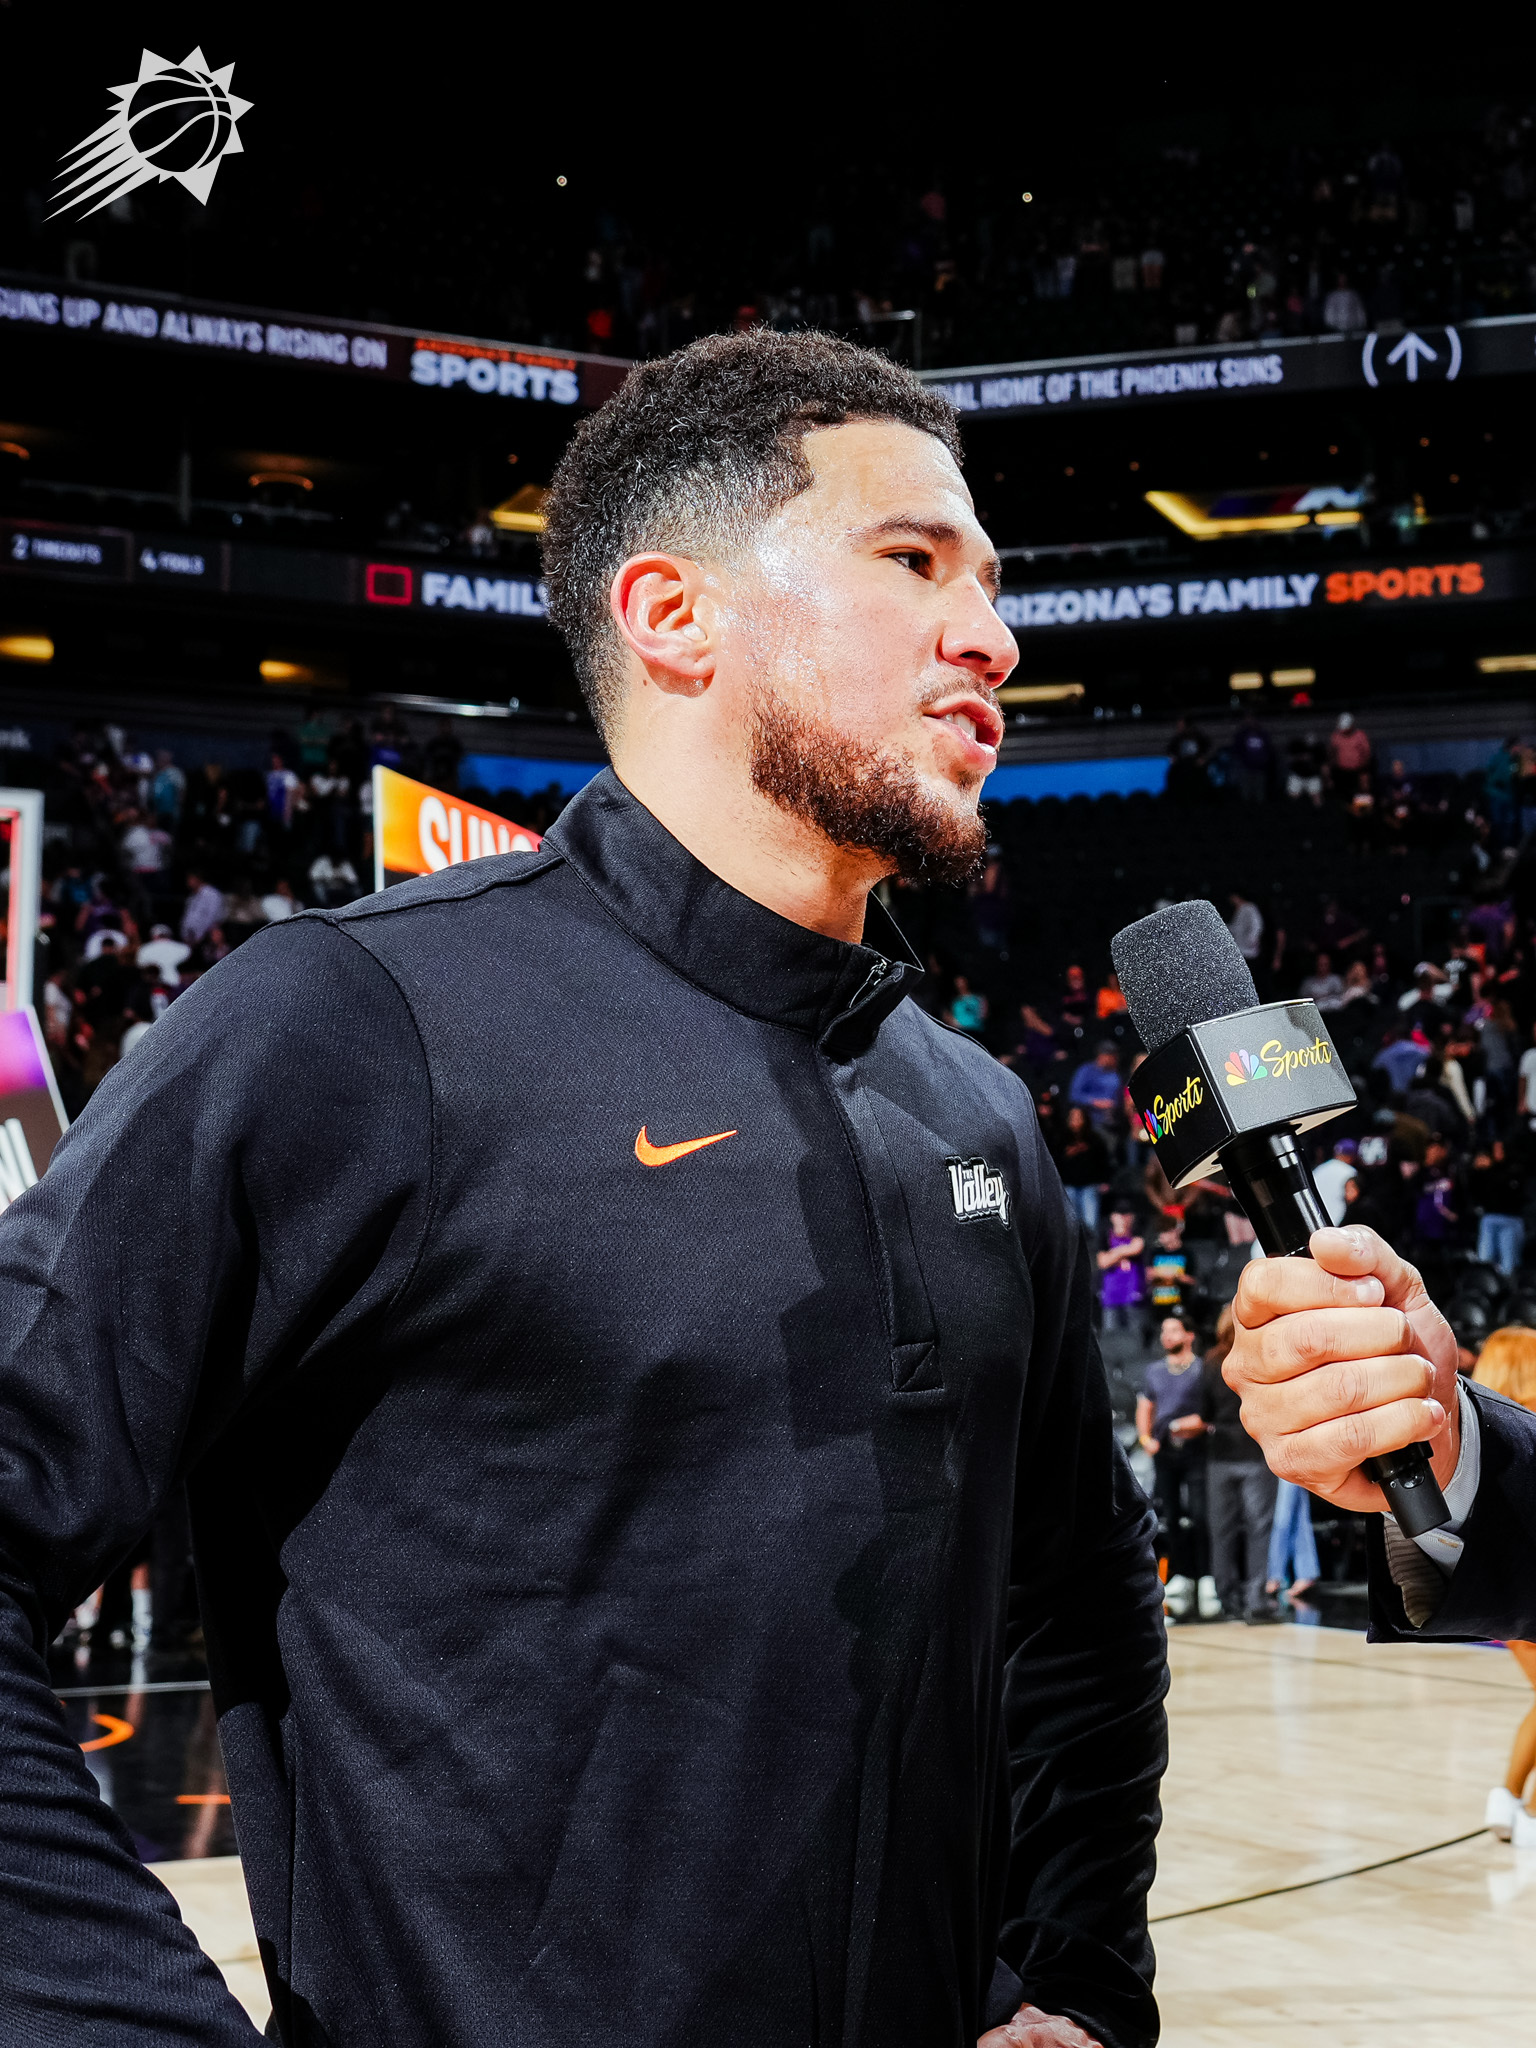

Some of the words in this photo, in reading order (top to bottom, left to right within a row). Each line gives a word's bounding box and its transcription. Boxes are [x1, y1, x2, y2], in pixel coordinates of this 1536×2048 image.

[62, 294, 101, 329] UP
[101, 301, 159, 338] AND
[160, 309, 263, 353] ALWAYS
[265, 323, 349, 365] RISING
[350, 335, 388, 370] ON
[411, 350, 580, 405] SPORTS
[980, 374, 1045, 410] HOME
[1046, 371, 1076, 404] OF
[1078, 367, 1120, 399] THE
[1121, 360, 1219, 397] PHOENIX
[1219, 353, 1284, 389] SUNS
[997, 583, 1174, 628] RIZONA'S
[1178, 573, 1320, 615] FAMILY
[1325, 562, 1485, 604] SPORTS
[418, 795, 533, 873] SUN
[1260, 1037, 1332, 1082] Sports
[1153, 1076, 1204, 1137] Sports
[947, 1163, 1010, 1221] Valley
[962, 1169, 974, 1180] THE
